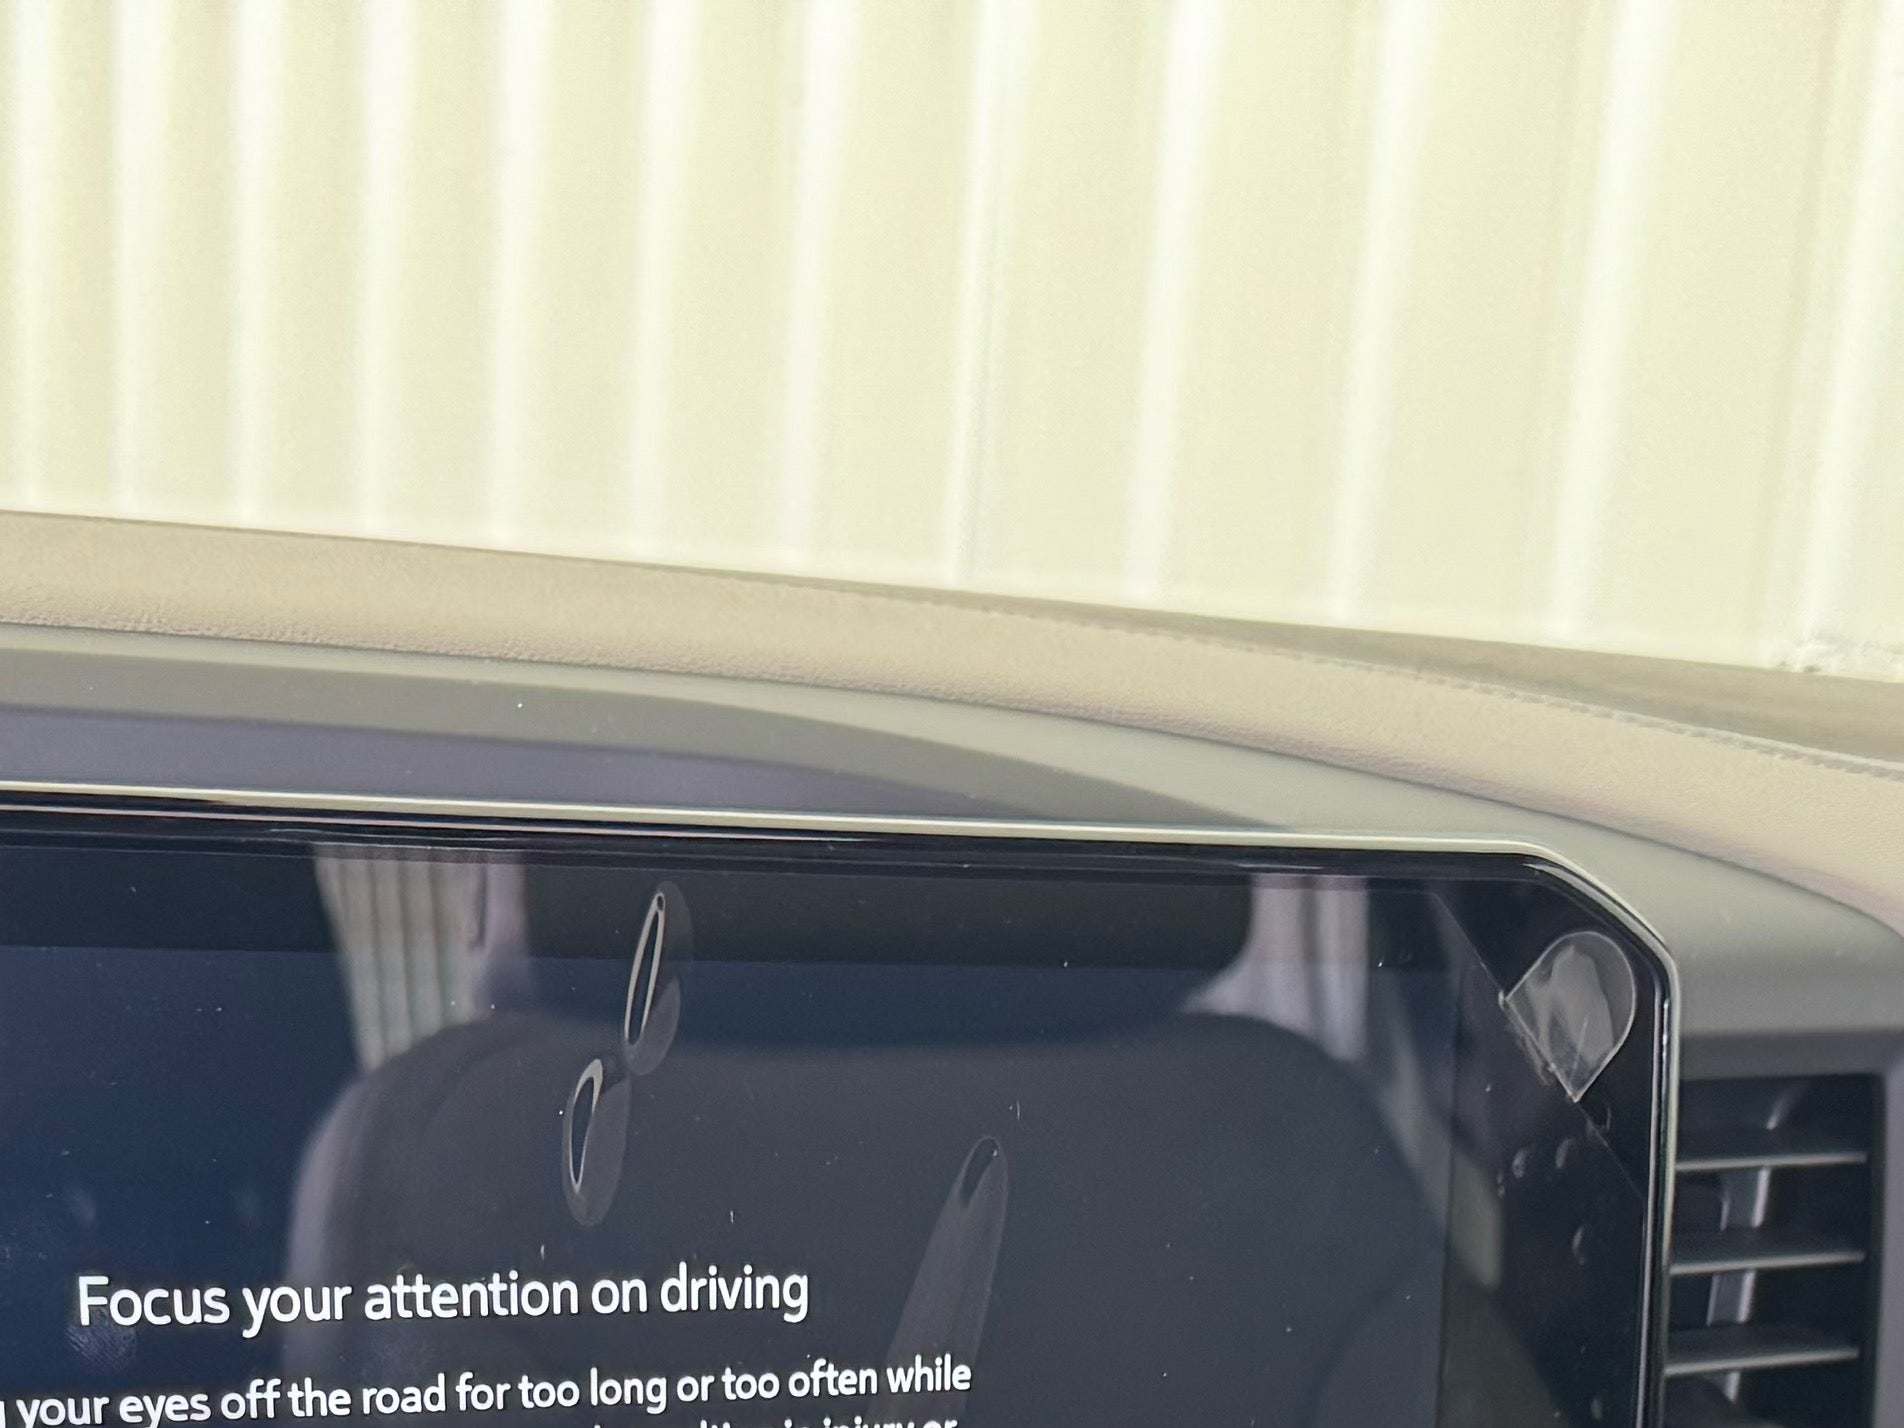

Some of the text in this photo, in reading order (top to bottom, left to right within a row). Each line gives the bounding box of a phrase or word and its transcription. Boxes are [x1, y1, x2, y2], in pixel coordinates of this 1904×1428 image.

[78, 1261, 808, 1339] Focus your attention on driving
[220, 1378, 282, 1420] off
[286, 1376, 352, 1417] the
[362, 1372, 446, 1415] road
[455, 1371, 512, 1411] for
[517, 1374, 580, 1409] too
[589, 1367, 667, 1415] long
[676, 1375, 715, 1402] or
[721, 1367, 780, 1401] too
[787, 1357, 878, 1398] often
[886, 1353, 972, 1393] while
